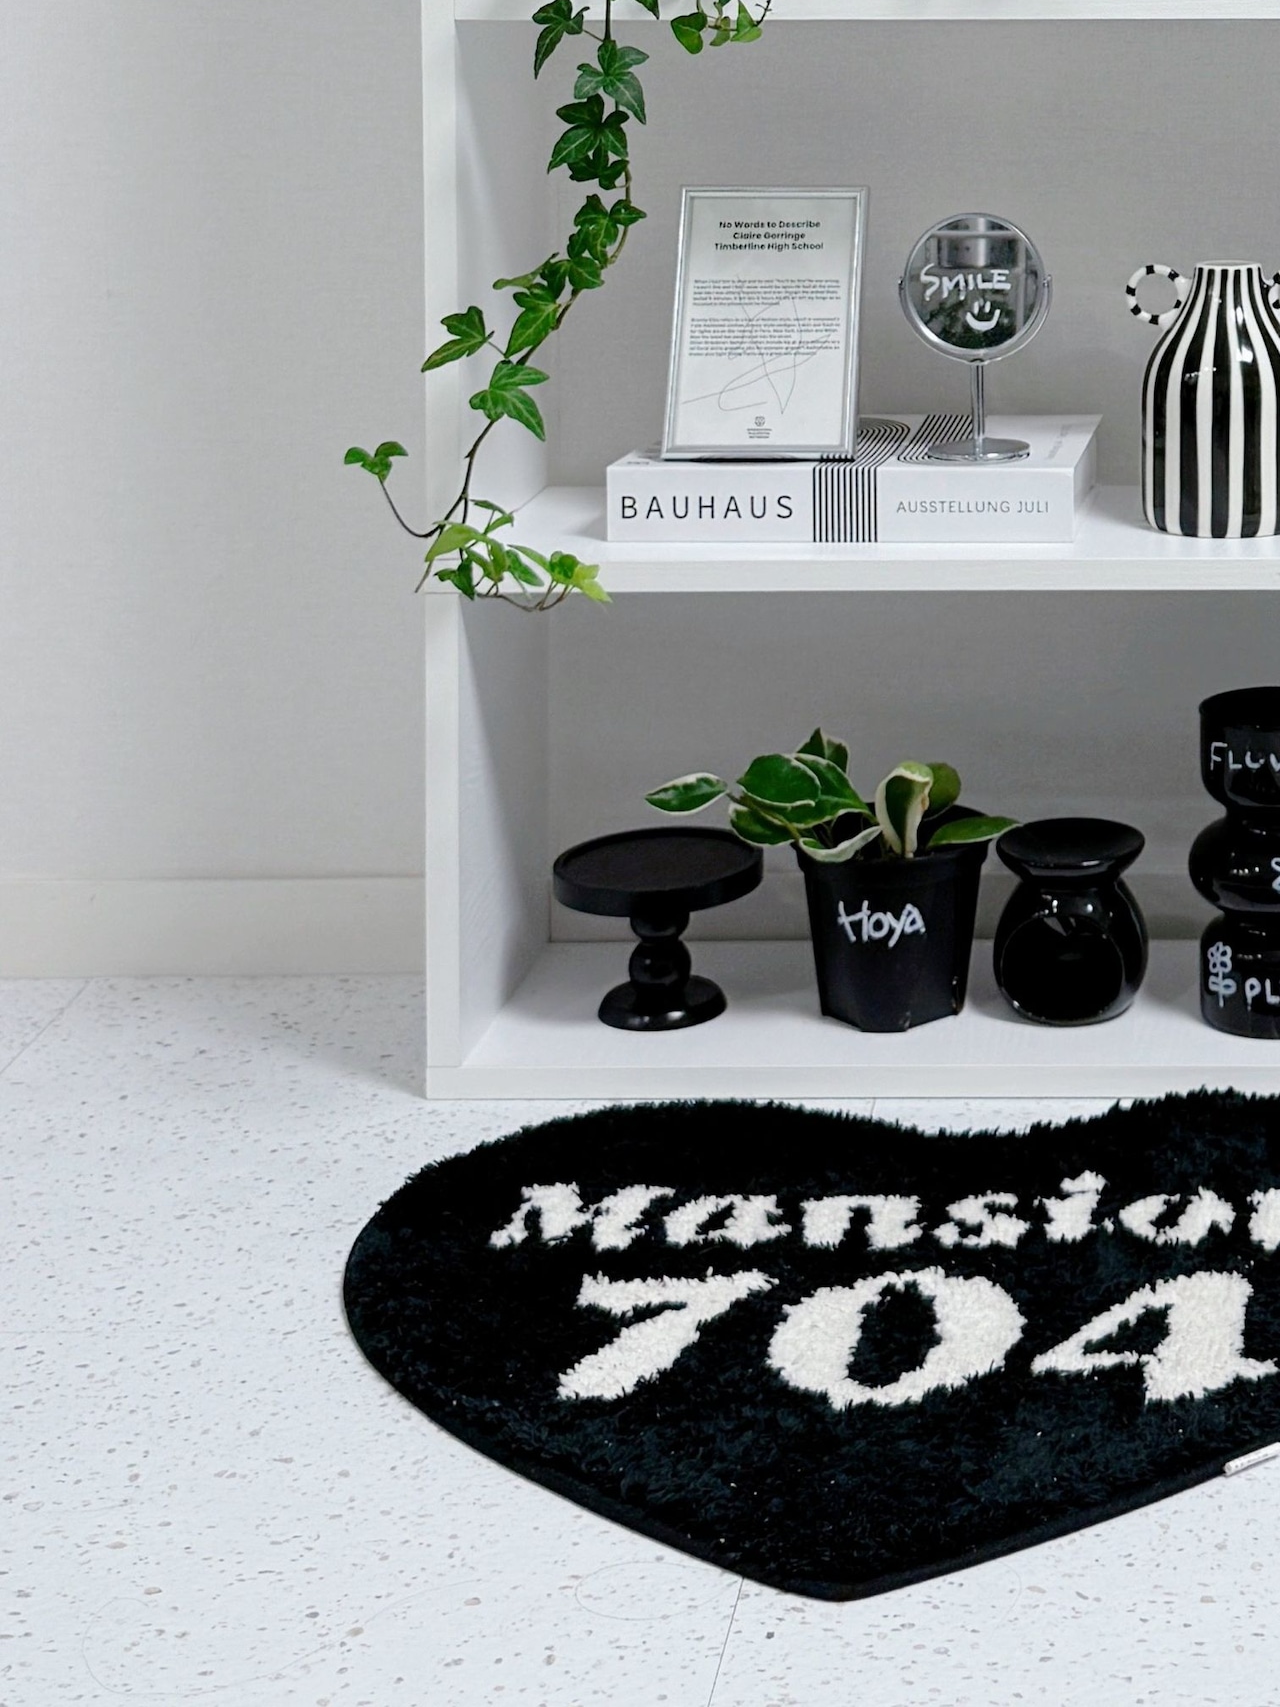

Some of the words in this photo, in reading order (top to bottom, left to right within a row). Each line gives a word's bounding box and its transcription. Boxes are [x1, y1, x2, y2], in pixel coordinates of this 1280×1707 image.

[719, 220, 733, 229] No
[734, 220, 765, 229] Words
[767, 220, 777, 229] to
[778, 220, 821, 229] Describe
[732, 231, 762, 240] Claire
[766, 241, 790, 253] High
[791, 241, 824, 251] School
[920, 263, 1012, 302] SMILE
[621, 495, 793, 519] BAUHAUS
[896, 500, 1011, 513] AUSSTELLUNG
[1017, 500, 1049, 513] JULI
[556, 1266, 1280, 1411] 704
